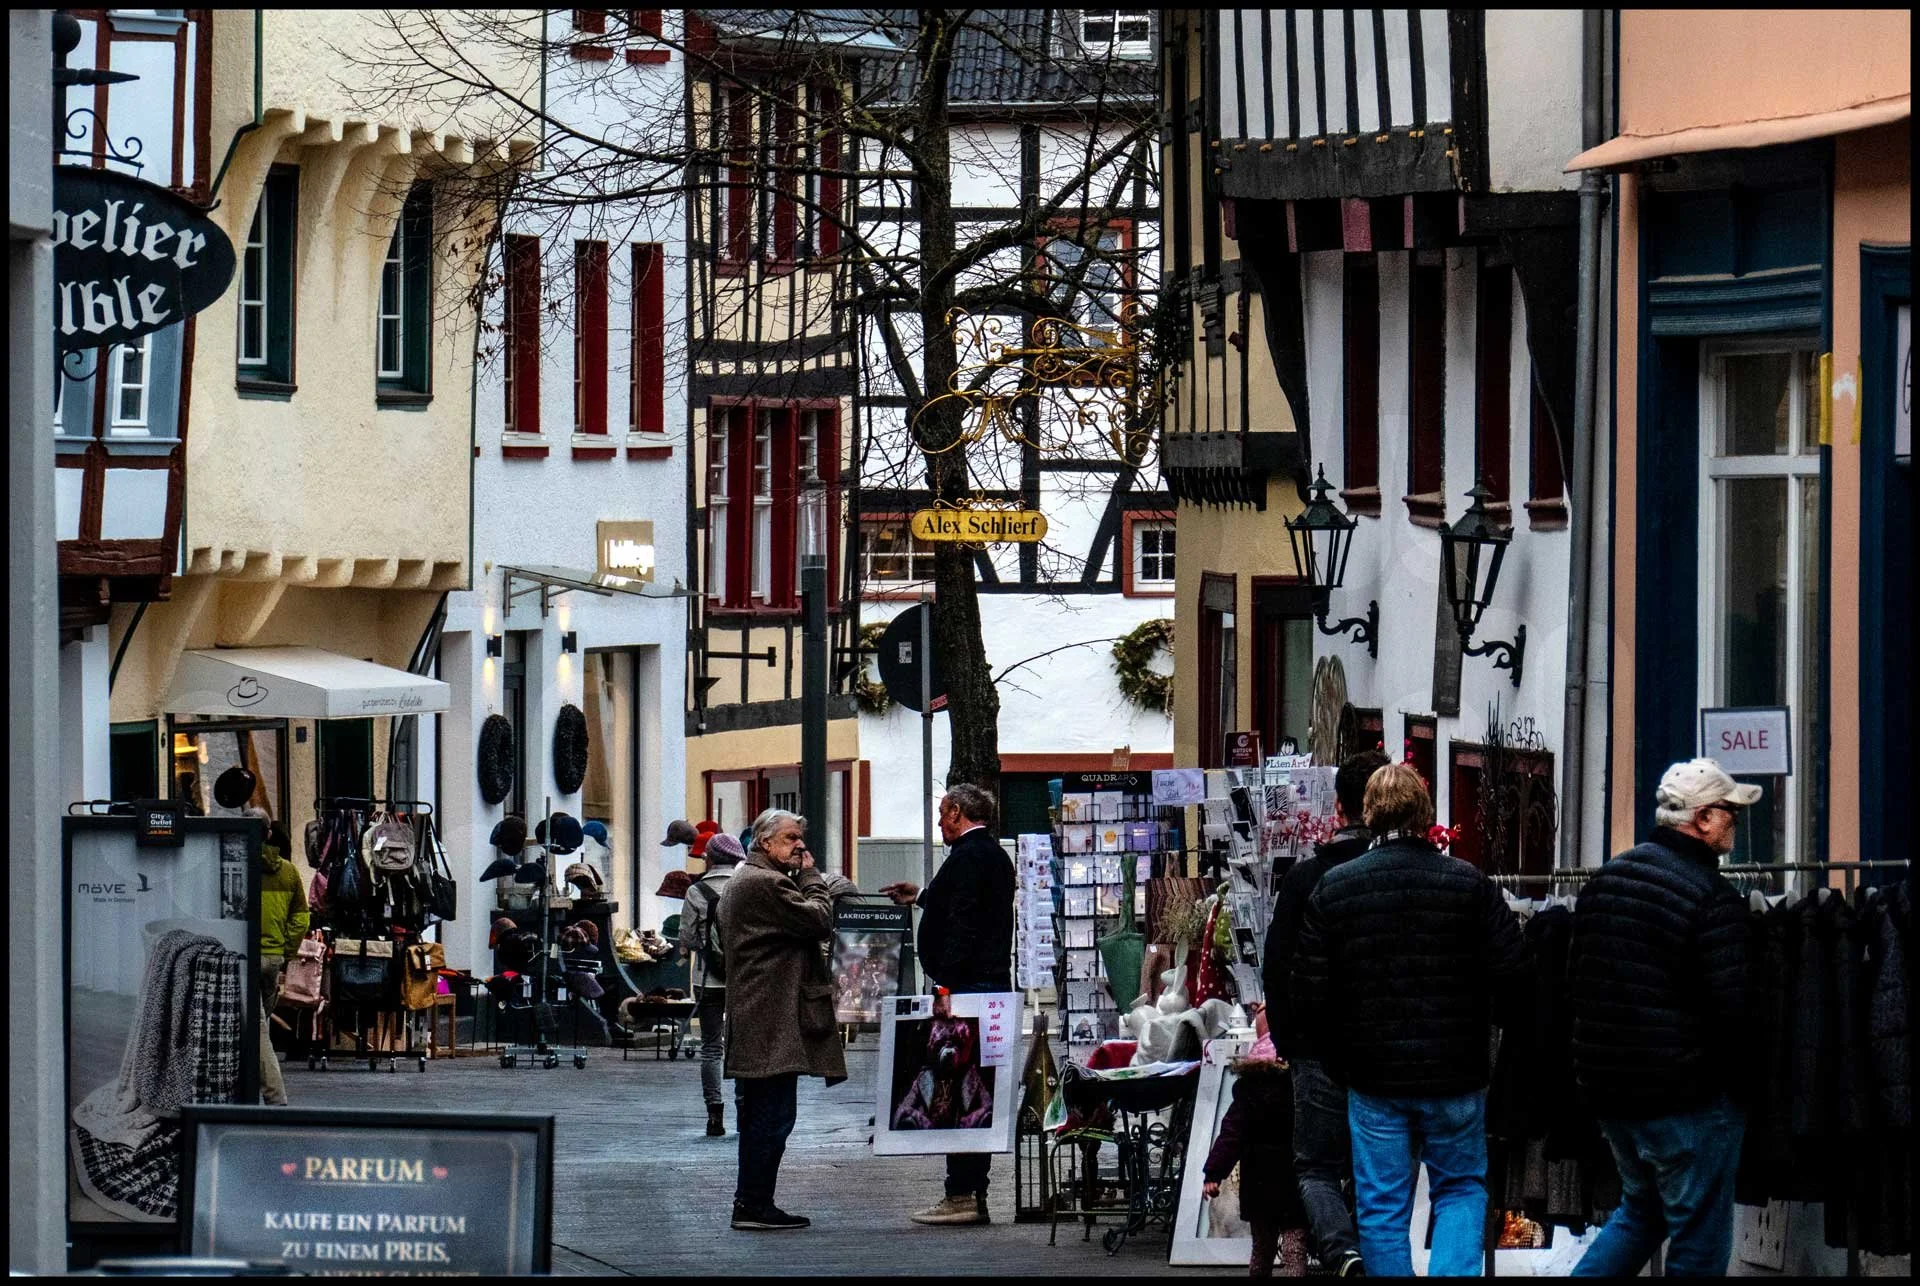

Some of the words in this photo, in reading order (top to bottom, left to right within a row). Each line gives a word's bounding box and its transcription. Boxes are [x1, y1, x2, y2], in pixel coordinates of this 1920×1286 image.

[58, 275, 171, 336] lble
[922, 515, 962, 535] Alex
[968, 515, 1039, 535] Schlierf
[1721, 729, 1769, 751] SALE
[874, 912, 902, 920] BÜLOW
[988, 1001, 996, 1009] 20
[305, 1157, 425, 1183] PARFUM
[264, 1212, 332, 1232] KAUFE
[337, 1213, 372, 1233] EIN
[377, 1214, 467, 1235] PARFUM
[282, 1242, 310, 1259] ZU
[315, 1243, 380, 1261] EINEM
[385, 1241, 451, 1265] PREIS,
